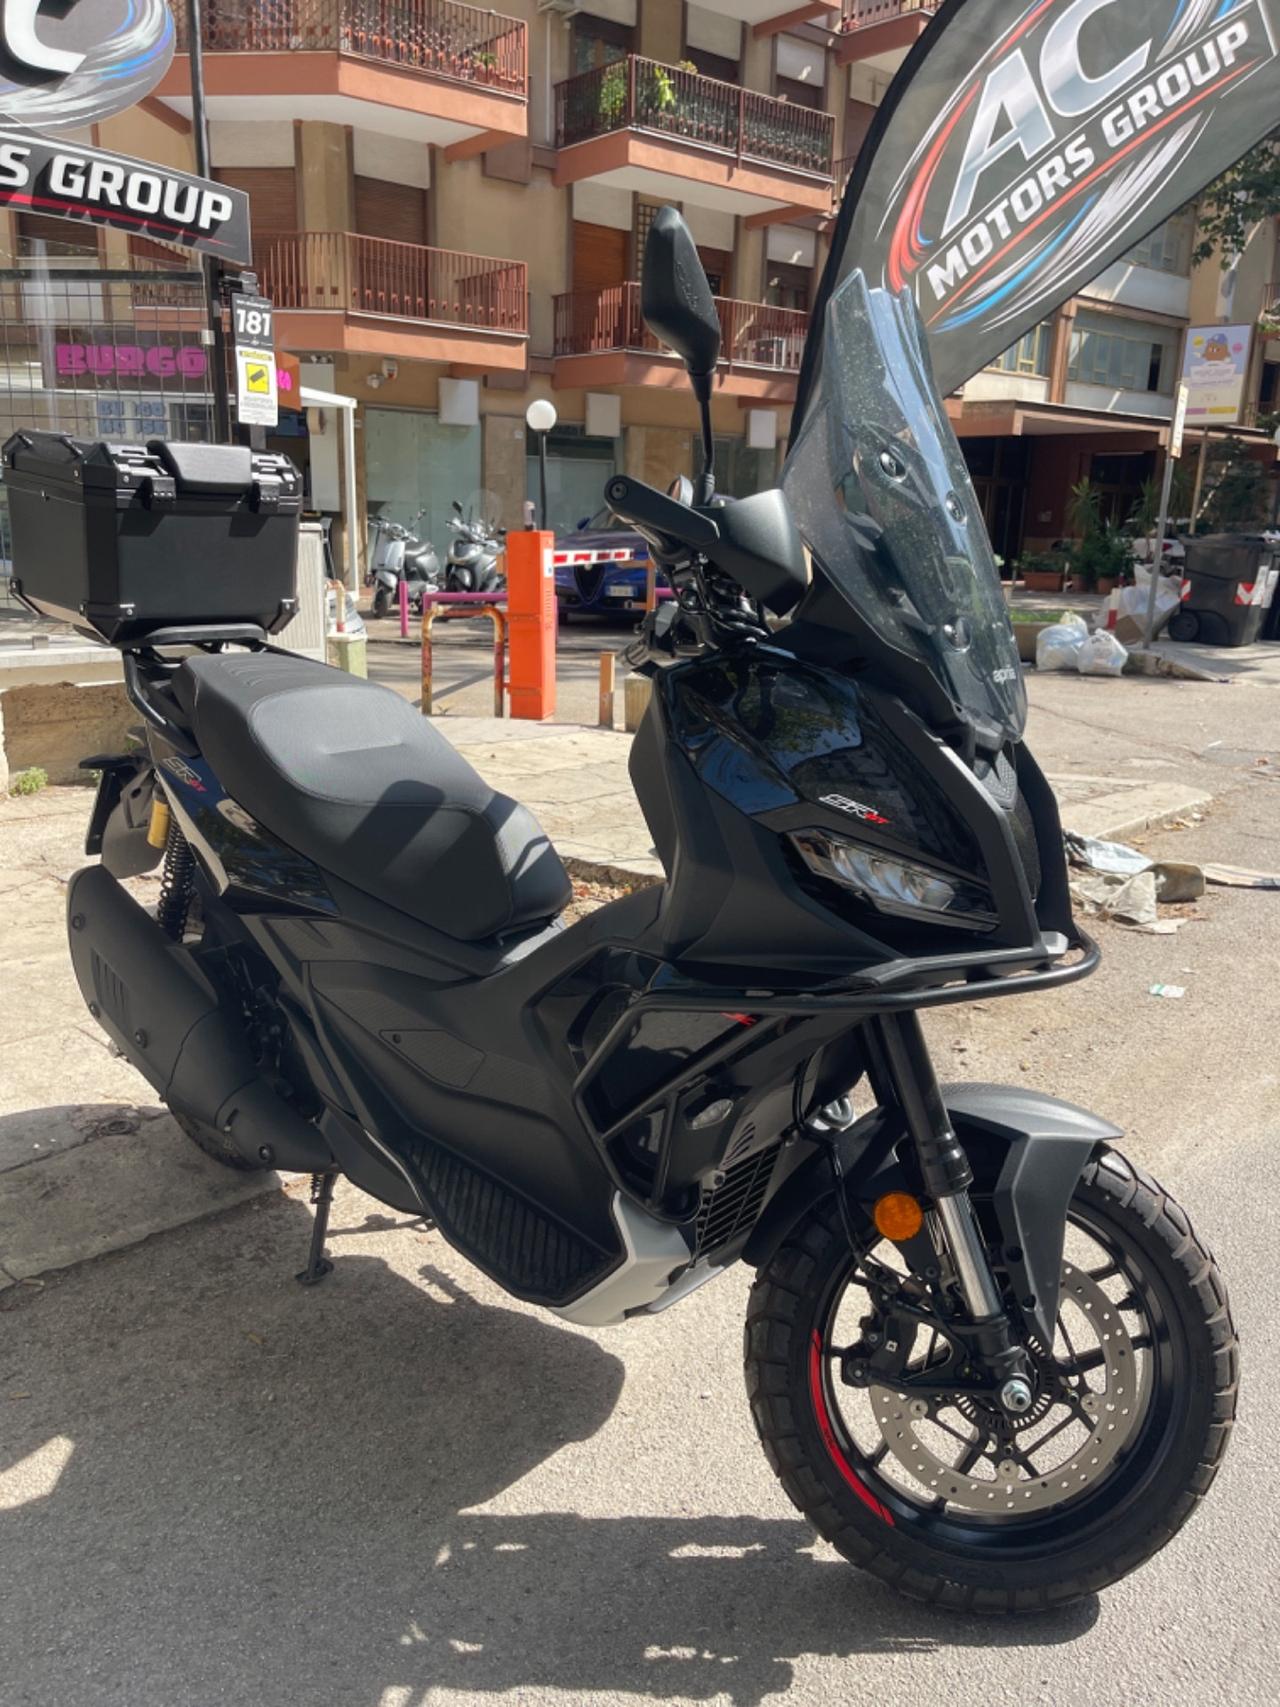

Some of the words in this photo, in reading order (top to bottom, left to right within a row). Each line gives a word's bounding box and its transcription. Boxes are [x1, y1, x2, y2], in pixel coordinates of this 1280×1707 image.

[50, 154, 233, 229] GROUP
[926, 134, 1095, 300] MOTORS
[1101, 20, 1248, 148] GROUP
[236, 308, 272, 337] 181
